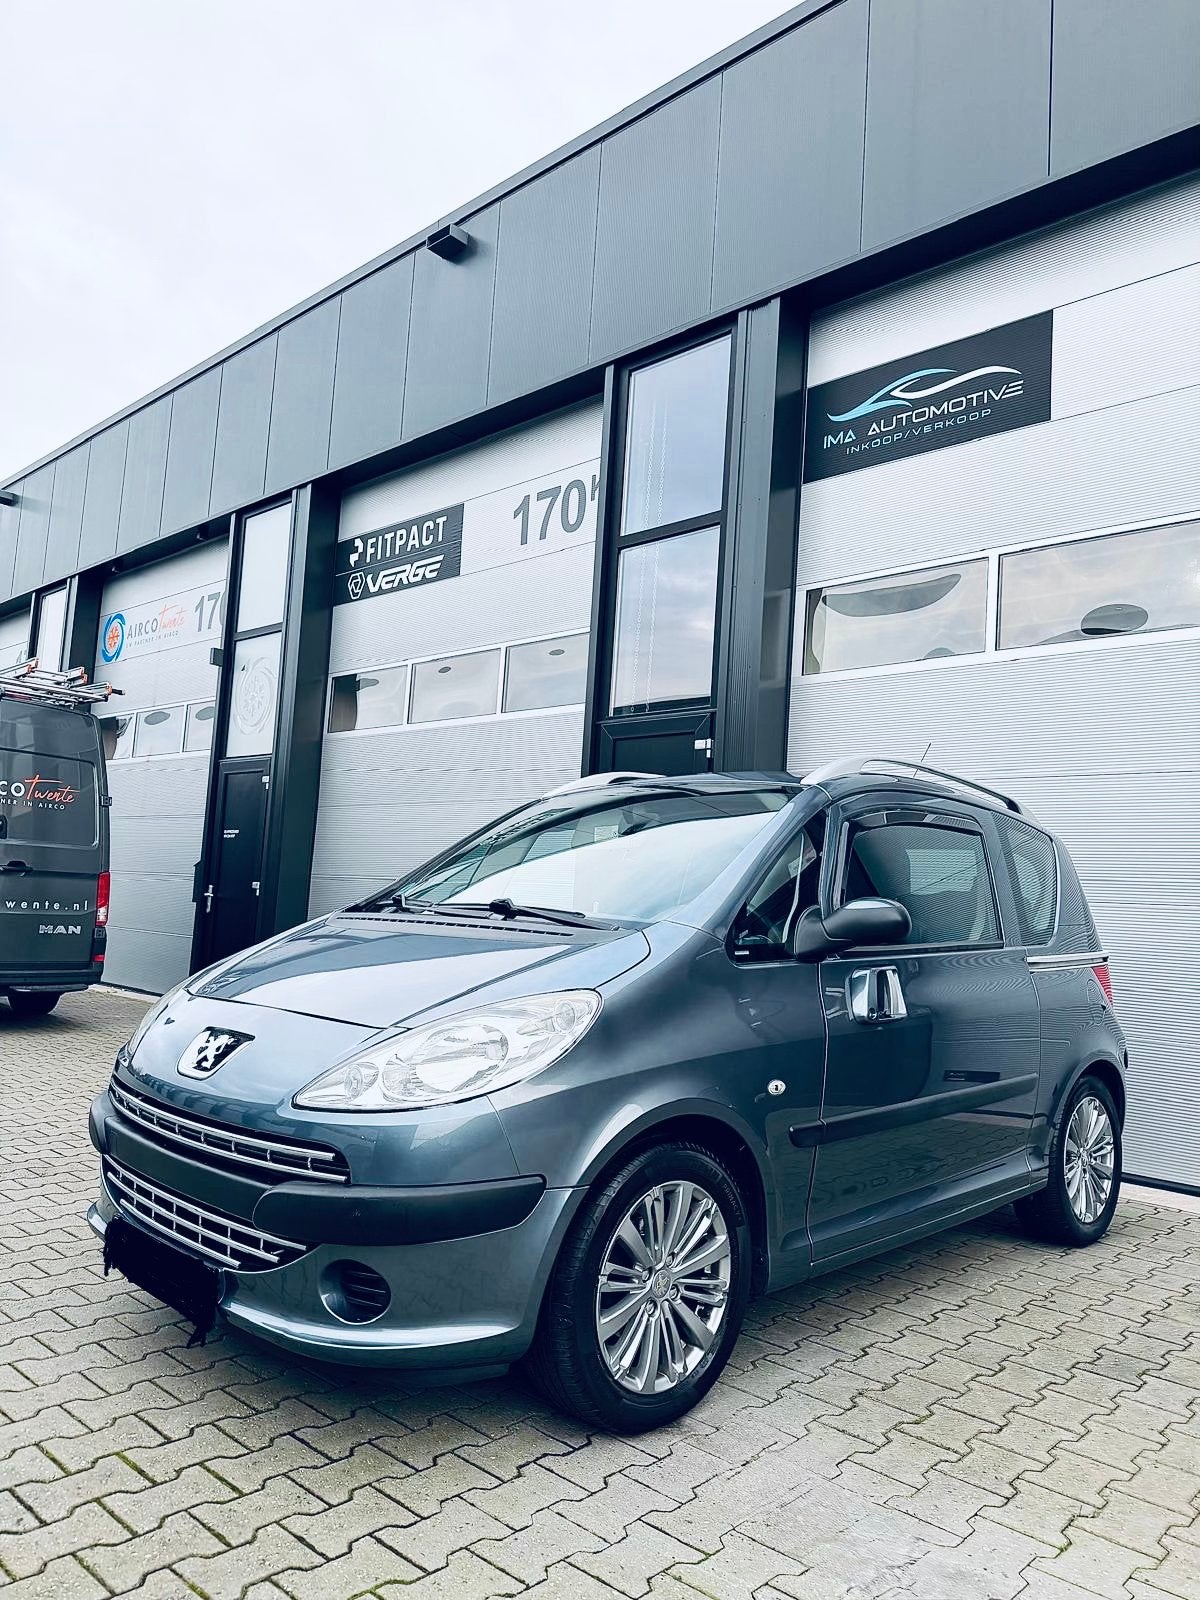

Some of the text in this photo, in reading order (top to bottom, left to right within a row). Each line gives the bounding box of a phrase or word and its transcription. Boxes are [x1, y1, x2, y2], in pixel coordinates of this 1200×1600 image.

[823, 380, 1024, 449] IMA AUTOMOTIVE
[846, 408, 992, 455] INKOOP/VERKOOP
[366, 516, 447, 563] FITPACT
[38, 802, 65, 810] AIRCO
[5, 900, 89, 911] wente.nl
[39, 924, 82, 935] MAN
